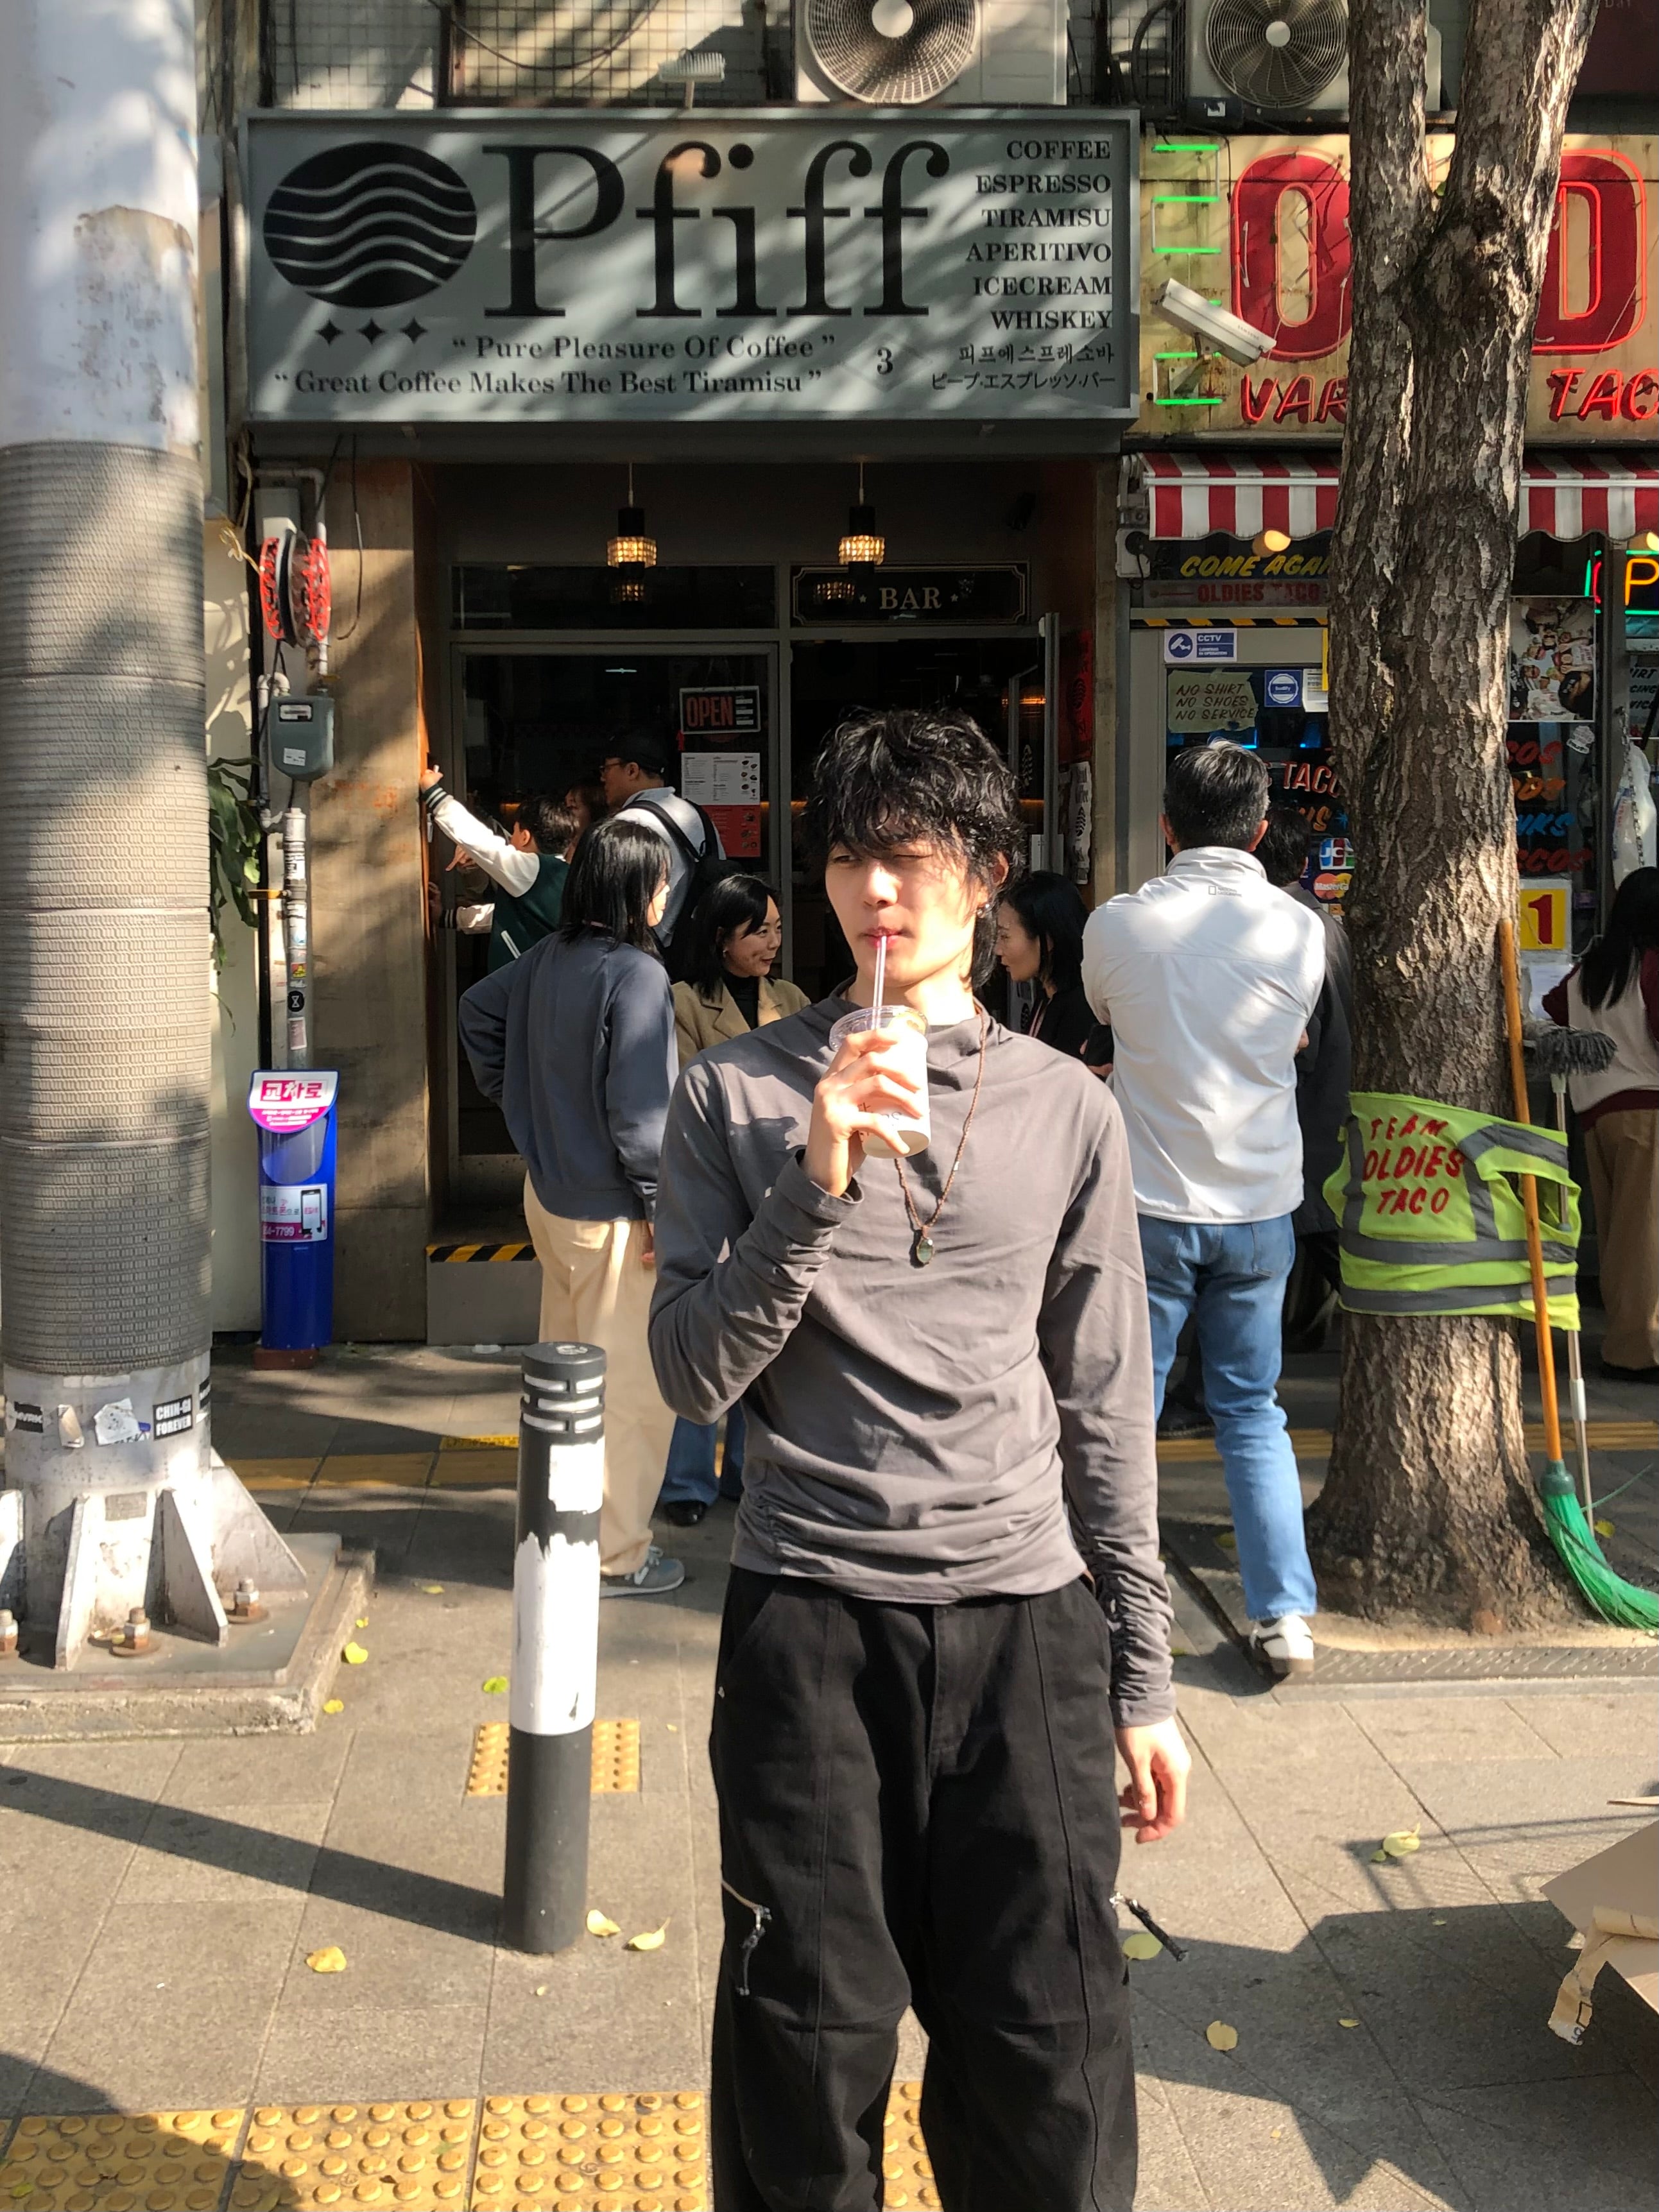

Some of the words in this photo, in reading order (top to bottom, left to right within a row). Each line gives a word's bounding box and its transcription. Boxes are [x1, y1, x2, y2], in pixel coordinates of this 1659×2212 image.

[1006, 139, 1112, 160] COFFEE
[976, 174, 1112, 194] ESPRESSO
[482, 139, 950, 318] Pfiff
[981, 208, 1112, 228] TIRAMISU
[966, 242, 1112, 262] APERITIVO
[973, 276, 1113, 296] ICECREAM
[991, 309, 1113, 330] WHISKEY
[475, 336, 543, 359] Pure
[553, 336, 675, 359] Pleasure
[684, 336, 719, 359] Of
[726, 336, 814, 359] Coffee
[877, 348, 893, 375] 3
[295, 370, 371, 395] Great
[378, 370, 461, 395] Coffee
[469, 370, 555, 395] Makes
[560, 370, 609, 394] The
[620, 370, 676, 394] Best
[682, 370, 802, 393] Tiramisu
[1241, 373, 1348, 424] VAR
[1180, 555, 1261, 577] COME
[1262, 554, 1332, 576] AGAI
[879, 587, 942, 610] BAR
[1197, 583, 1265, 603] OLDIES
[1630, 669, 1657, 679] IRT
[1176, 685, 1199, 696] NO
[1204, 683, 1244, 695] SHIRT
[685, 696, 734, 727] OPEN
[1175, 697, 1199, 708] NO
[1203, 696, 1249, 707] SHOES
[1175, 710, 1196, 720] NO
[1201, 707, 1255, 720] SERVICE
[1527, 894, 1553, 945] 1
[1370, 1115, 1449, 1142] TEAM
[1362, 1145, 1466, 1182] OLDIES
[1376, 1187, 1450, 1215] TACO
